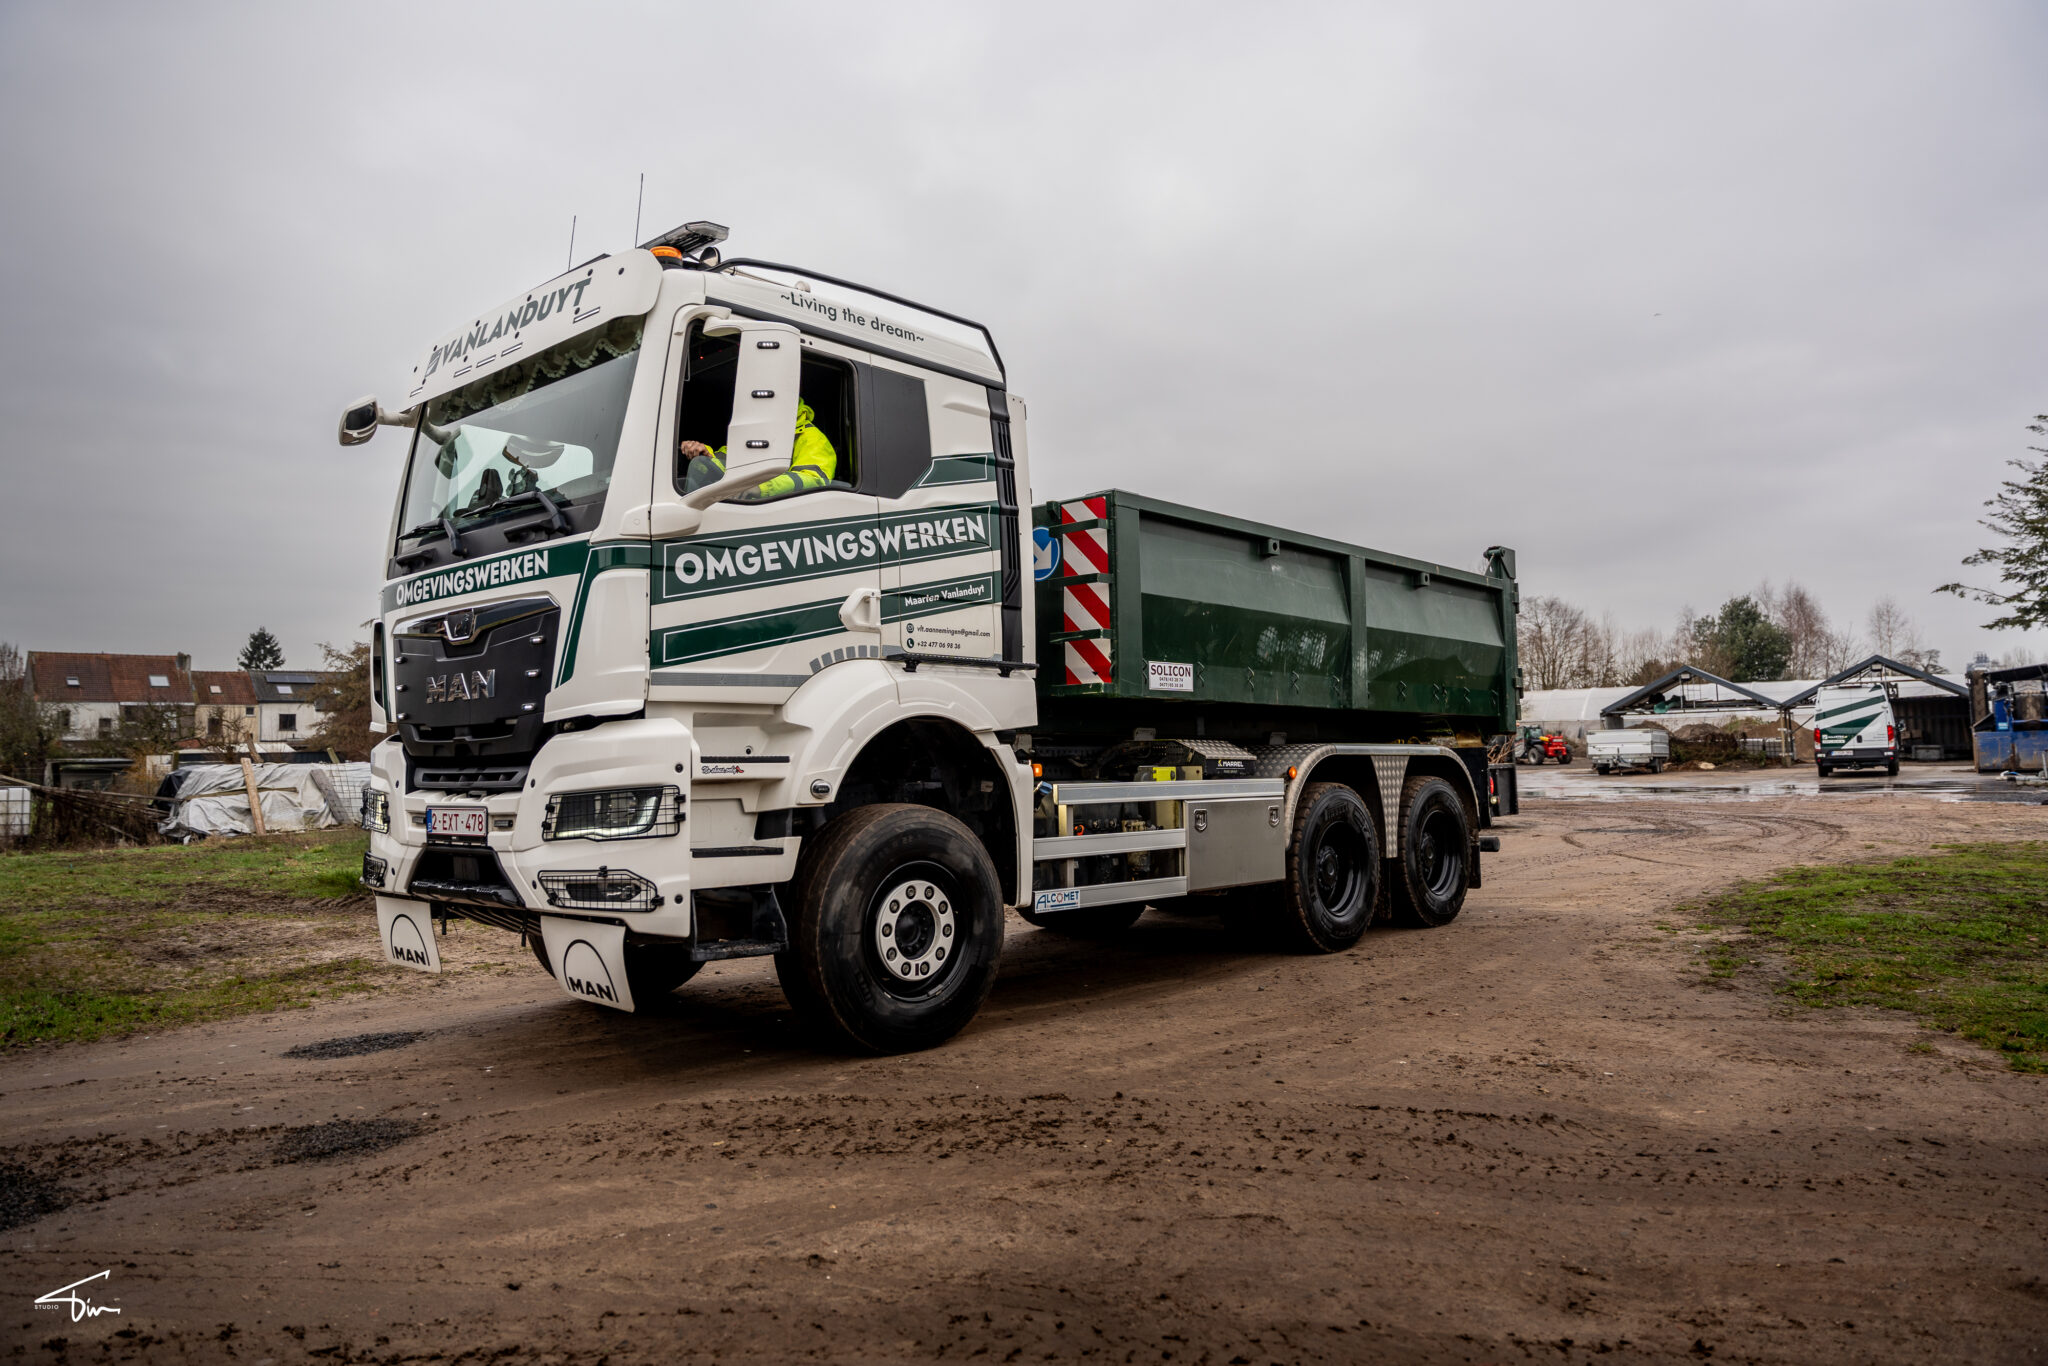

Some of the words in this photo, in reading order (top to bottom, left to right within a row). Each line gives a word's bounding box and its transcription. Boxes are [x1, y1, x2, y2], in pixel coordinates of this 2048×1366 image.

[440, 277, 592, 367] VANLANDUYT
[842, 308, 866, 326] the
[674, 514, 987, 585] OMGEVINGSWERKEN
[396, 550, 549, 606] OMGEVINGSWERKEN
[904, 593, 940, 607] Maarten
[940, 584, 985, 600] Vanlanduyt
[1150, 664, 1191, 677] SOLICON
[426, 669, 496, 704] MAN
[1036, 890, 1080, 910] ALCOMET
[394, 946, 427, 966] MAN
[568, 975, 612, 1002] MAN
